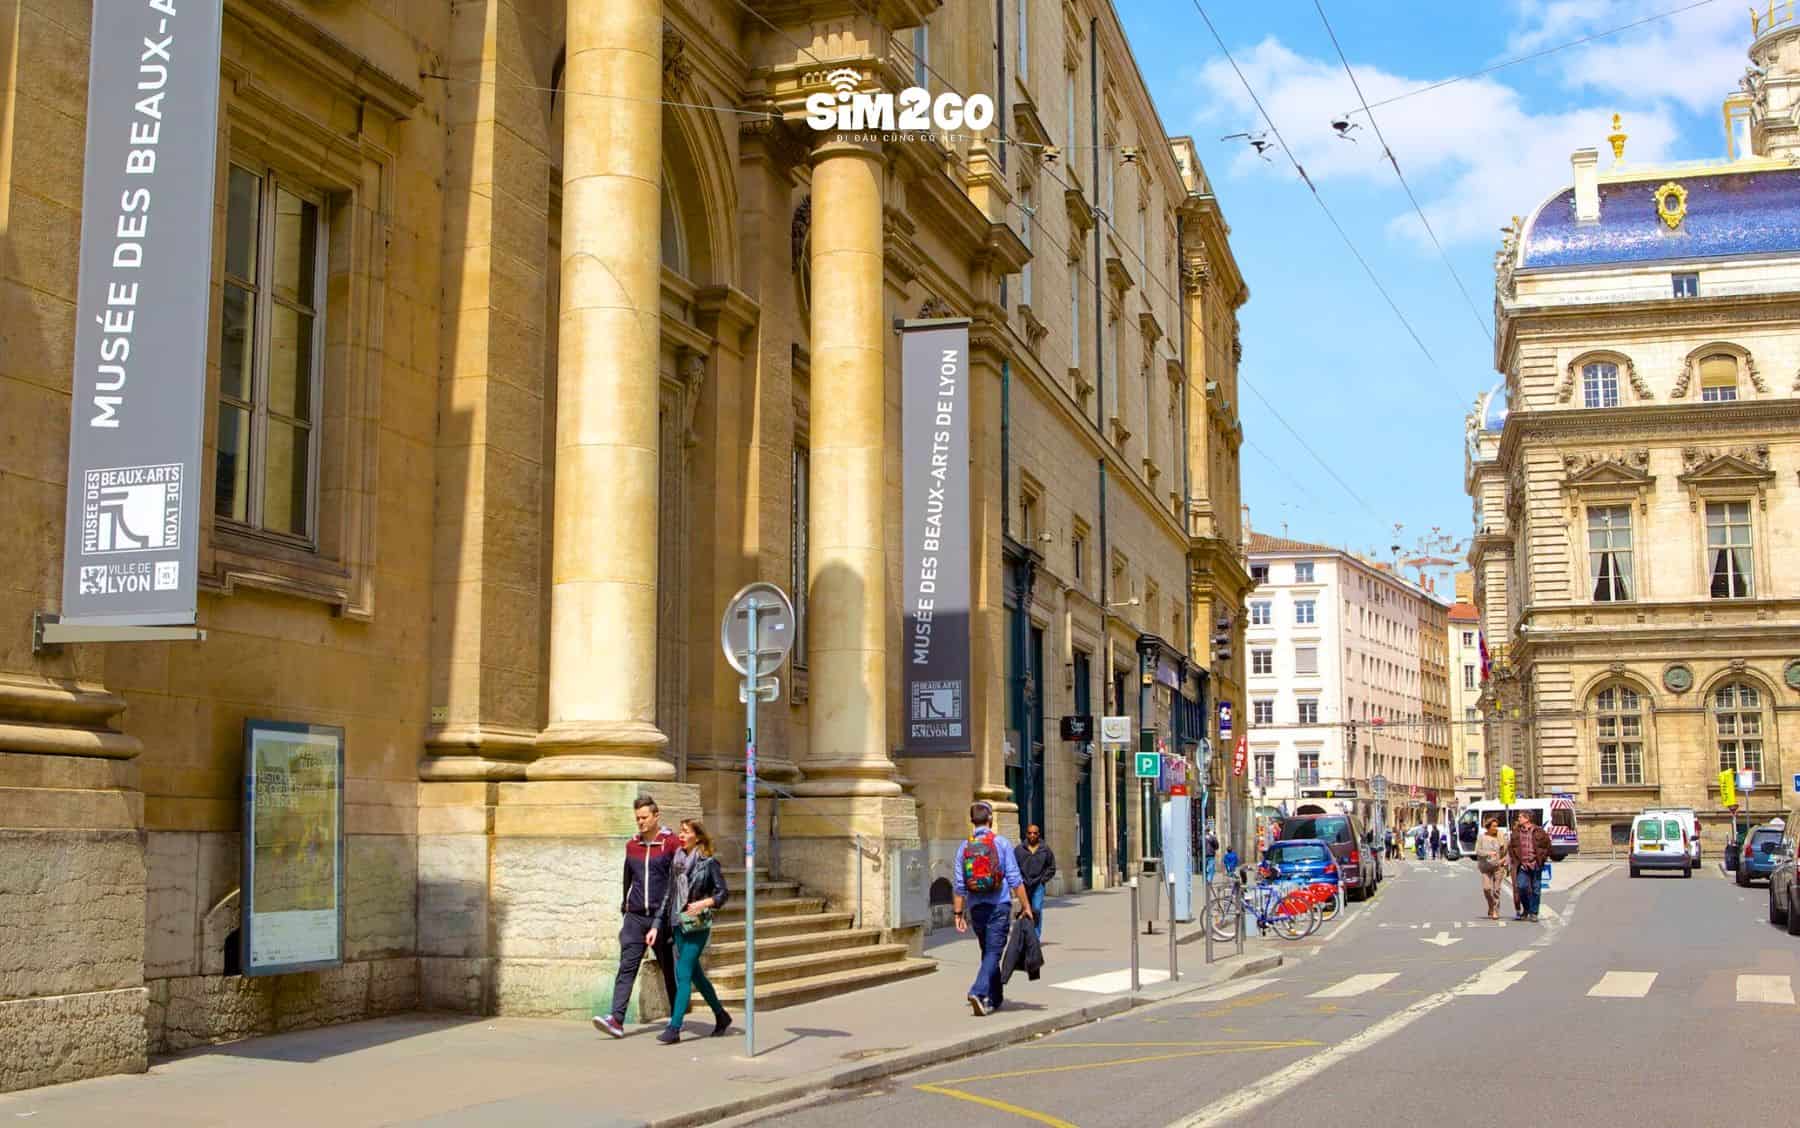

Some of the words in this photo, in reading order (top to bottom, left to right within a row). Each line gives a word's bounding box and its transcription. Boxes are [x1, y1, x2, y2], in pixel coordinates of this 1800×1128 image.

[112, 187, 151, 268] DES
[90, 282, 139, 428] MUSÉE
[938, 349, 958, 397] LYON
[936, 400, 953, 426] DE
[87, 472, 100, 500] DES
[101, 466, 180, 486] BEAUX-ARTS
[167, 482, 179, 501] DE
[924, 430, 950, 551] BEAUX-ARTS
[84, 503, 98, 551] MUSEE
[165, 507, 178, 546] LYON
[107, 575, 151, 593] LYON
[108, 562, 136, 575] VILLE
[138, 562, 152, 574] DE
[920, 557, 937, 593] DES
[913, 598, 934, 664] MUSÉE
[1142, 758, 1152, 773] P
[1233, 736, 1246, 776] TABAC
